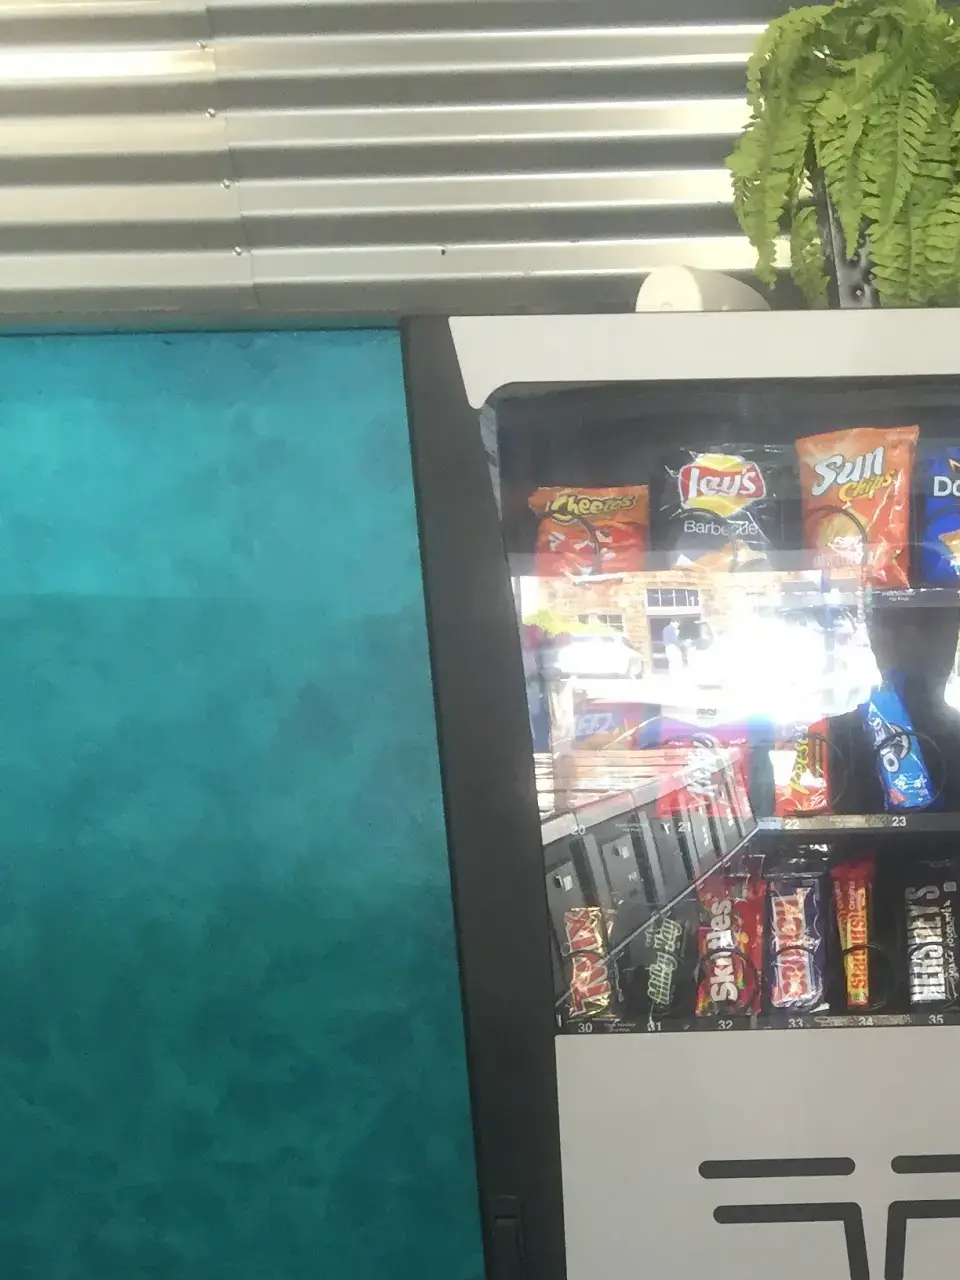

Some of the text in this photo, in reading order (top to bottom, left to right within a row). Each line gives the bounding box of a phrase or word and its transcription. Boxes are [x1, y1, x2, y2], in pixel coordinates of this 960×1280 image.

[811, 446, 884, 496] Sun
[688, 467, 756, 498] Lay's
[784, 819, 800, 829] 22
[892, 816, 907, 827] 23
[904, 885, 946, 1001] HERSHEY'S
[718, 1020, 733, 1030] 32
[788, 1018, 803, 1028] 33
[928, 1015, 944, 1025] 35
[578, 1023, 593, 1034] 30
[647, 1022, 662, 1032] 31
